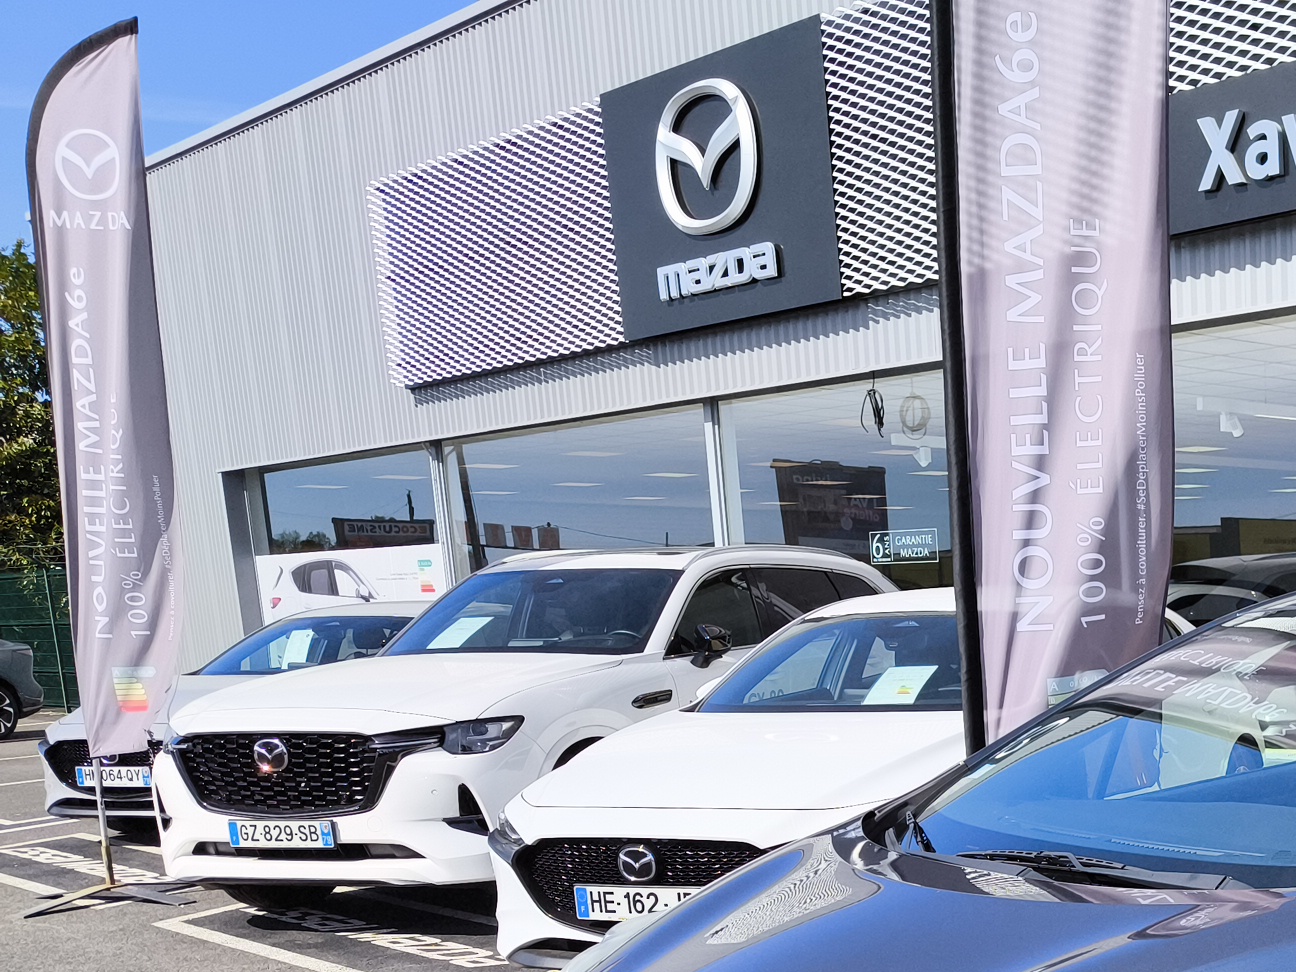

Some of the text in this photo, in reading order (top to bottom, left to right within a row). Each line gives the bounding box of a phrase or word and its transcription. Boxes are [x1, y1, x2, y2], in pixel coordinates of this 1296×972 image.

[50, 210, 132, 231] MAZDA
[994, 10, 1054, 633] NOUVELLE MAZDA6e
[1069, 217, 1109, 629] 100% ÉLECTRIQUE
[65, 266, 113, 640] NOUVELLE MAZDA6e
[1134, 352, 1149, 625] Pensez à covoiturer. #SeDéplacerMoinsPolluer
[872, 533, 884, 559] 6
[895, 534, 933, 546] GARANTIE
[900, 547, 930, 558] MAZDA
[119, 570, 151, 640] 100%
[240, 824, 320, 842] GZ-829-SB
